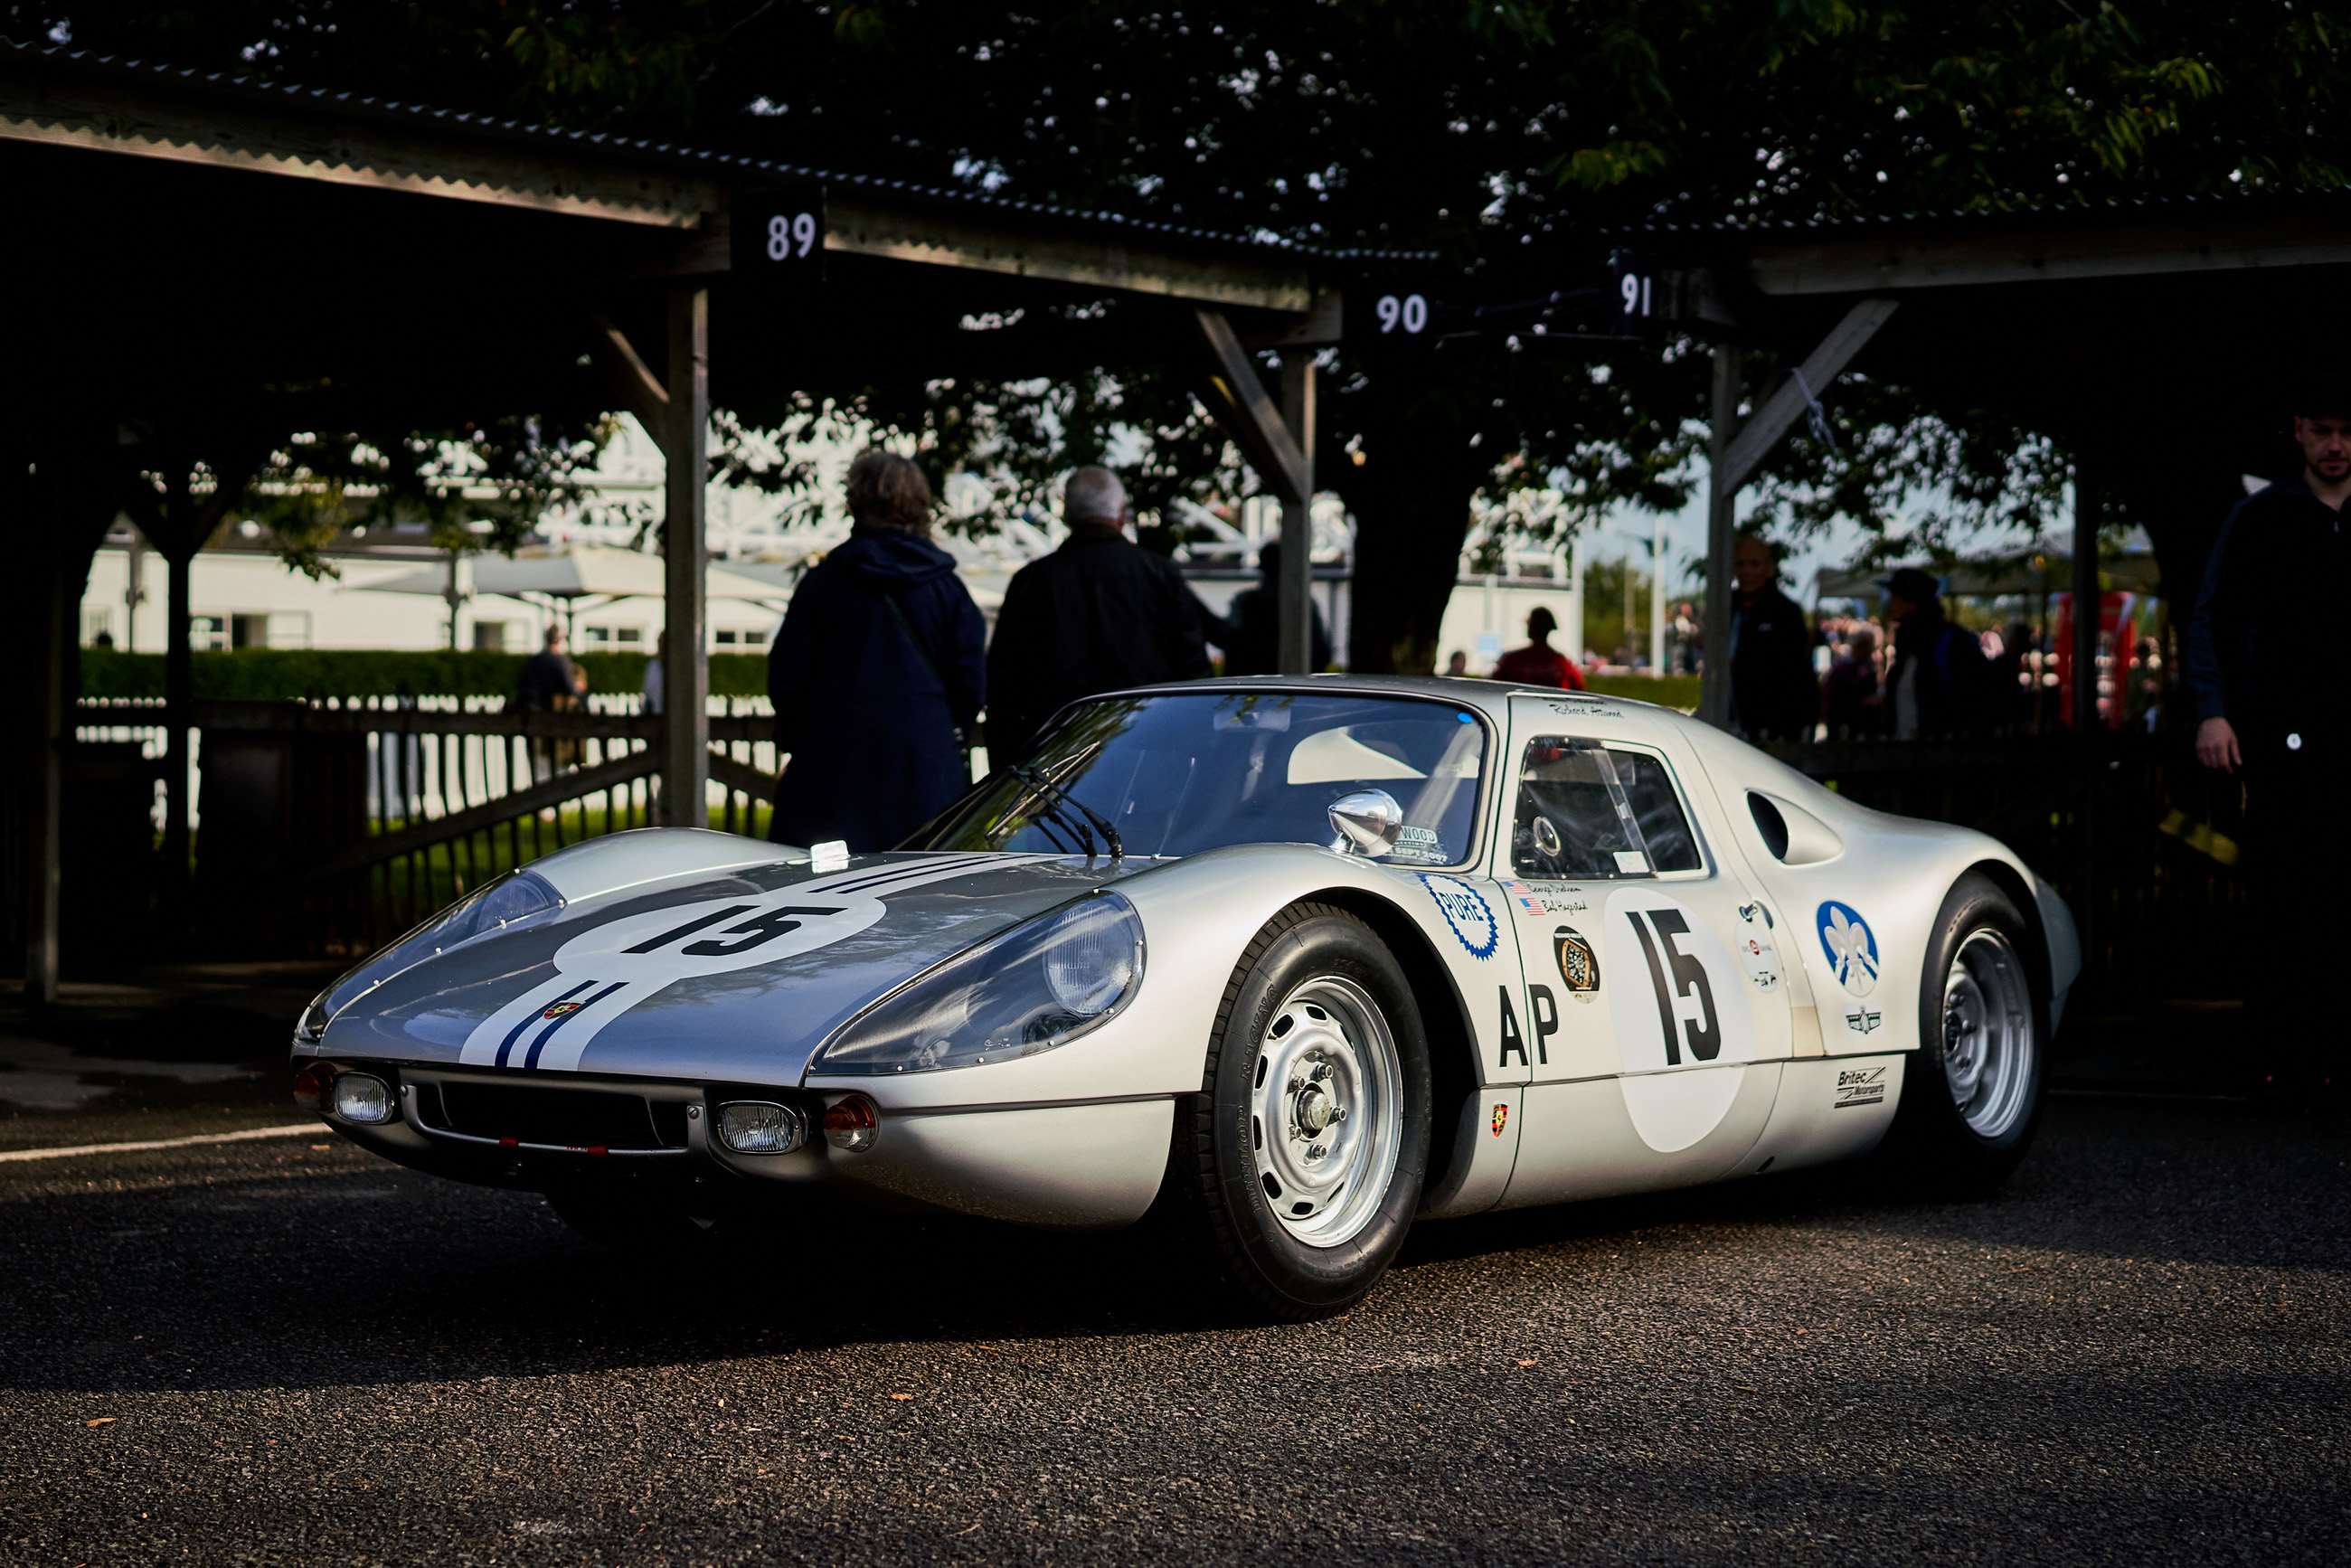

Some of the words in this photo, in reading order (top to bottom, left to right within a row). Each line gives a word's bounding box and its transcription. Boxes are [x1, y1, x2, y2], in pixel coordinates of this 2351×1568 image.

[767, 212, 816, 261] 89
[1376, 294, 1427, 334] 90
[1621, 273, 1651, 316] 91
[1439, 892, 1484, 921] PURE
[619, 904, 849, 957] 15
[1626, 908, 1722, 1066] 15
[1837, 1071, 1866, 1086] Britec
